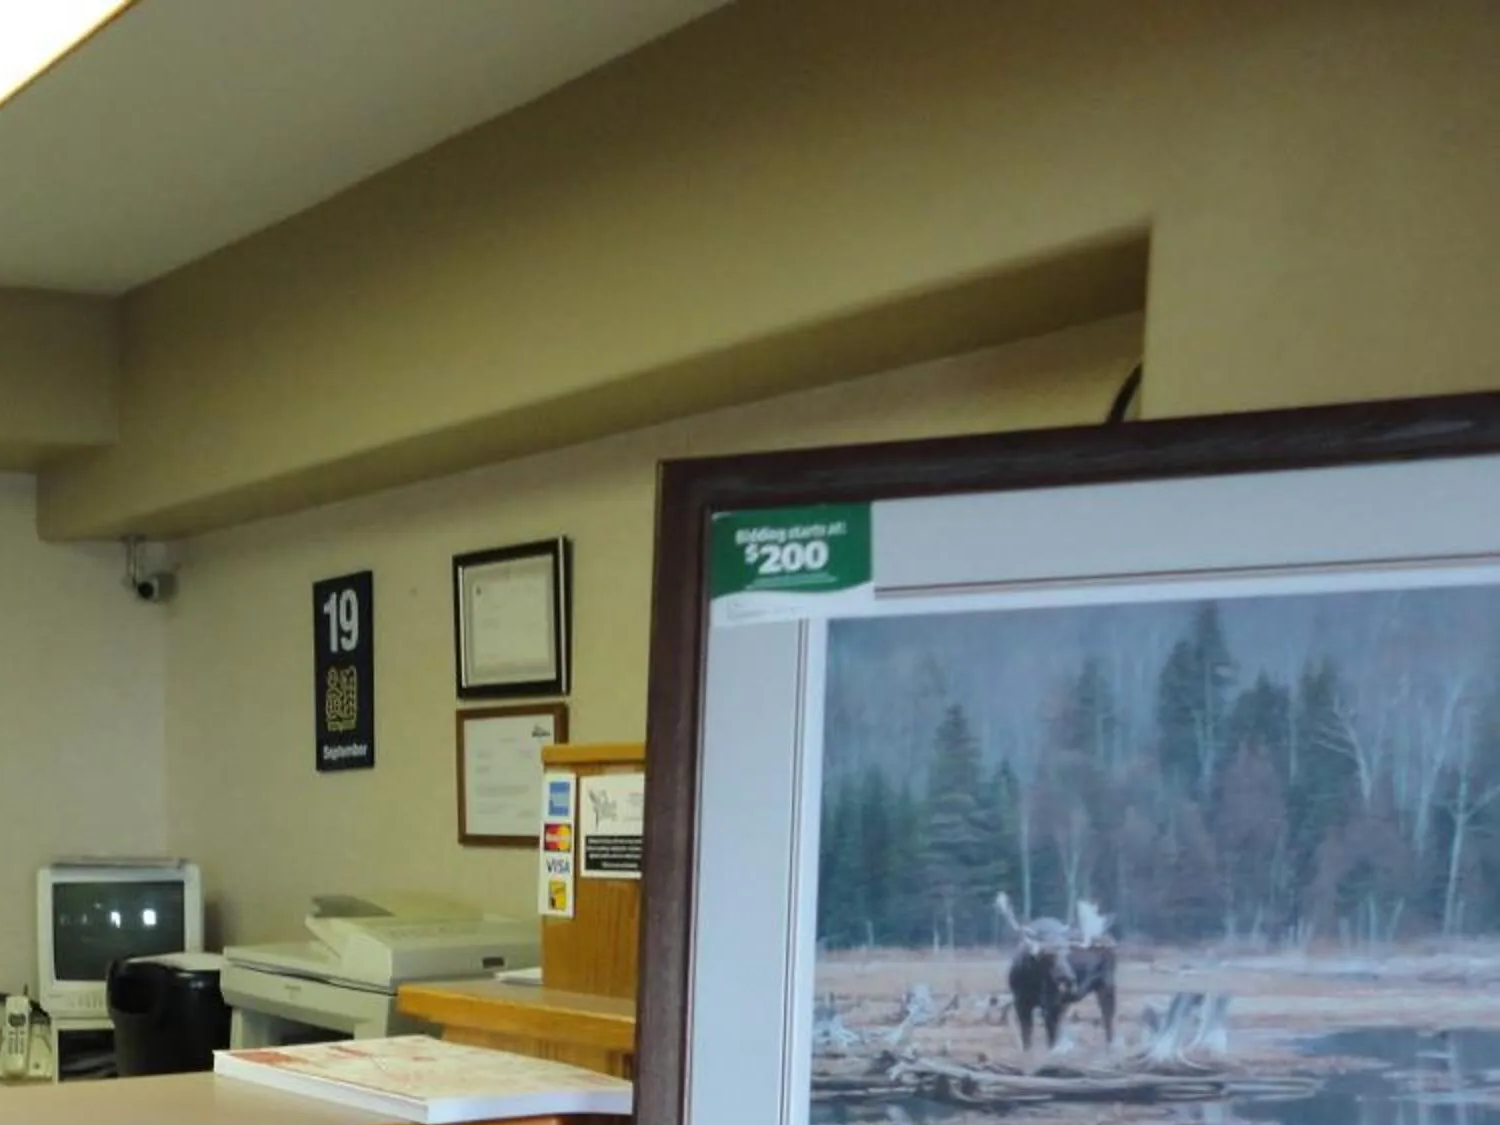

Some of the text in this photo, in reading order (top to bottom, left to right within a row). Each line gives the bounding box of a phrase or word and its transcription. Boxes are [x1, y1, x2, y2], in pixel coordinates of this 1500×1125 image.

[735, 525, 786, 545] Bidding
[745, 540, 829, 574] $200
[323, 588, 360, 653] 19
[323, 742, 368, 761] September
[545, 858, 570, 873] VISA
